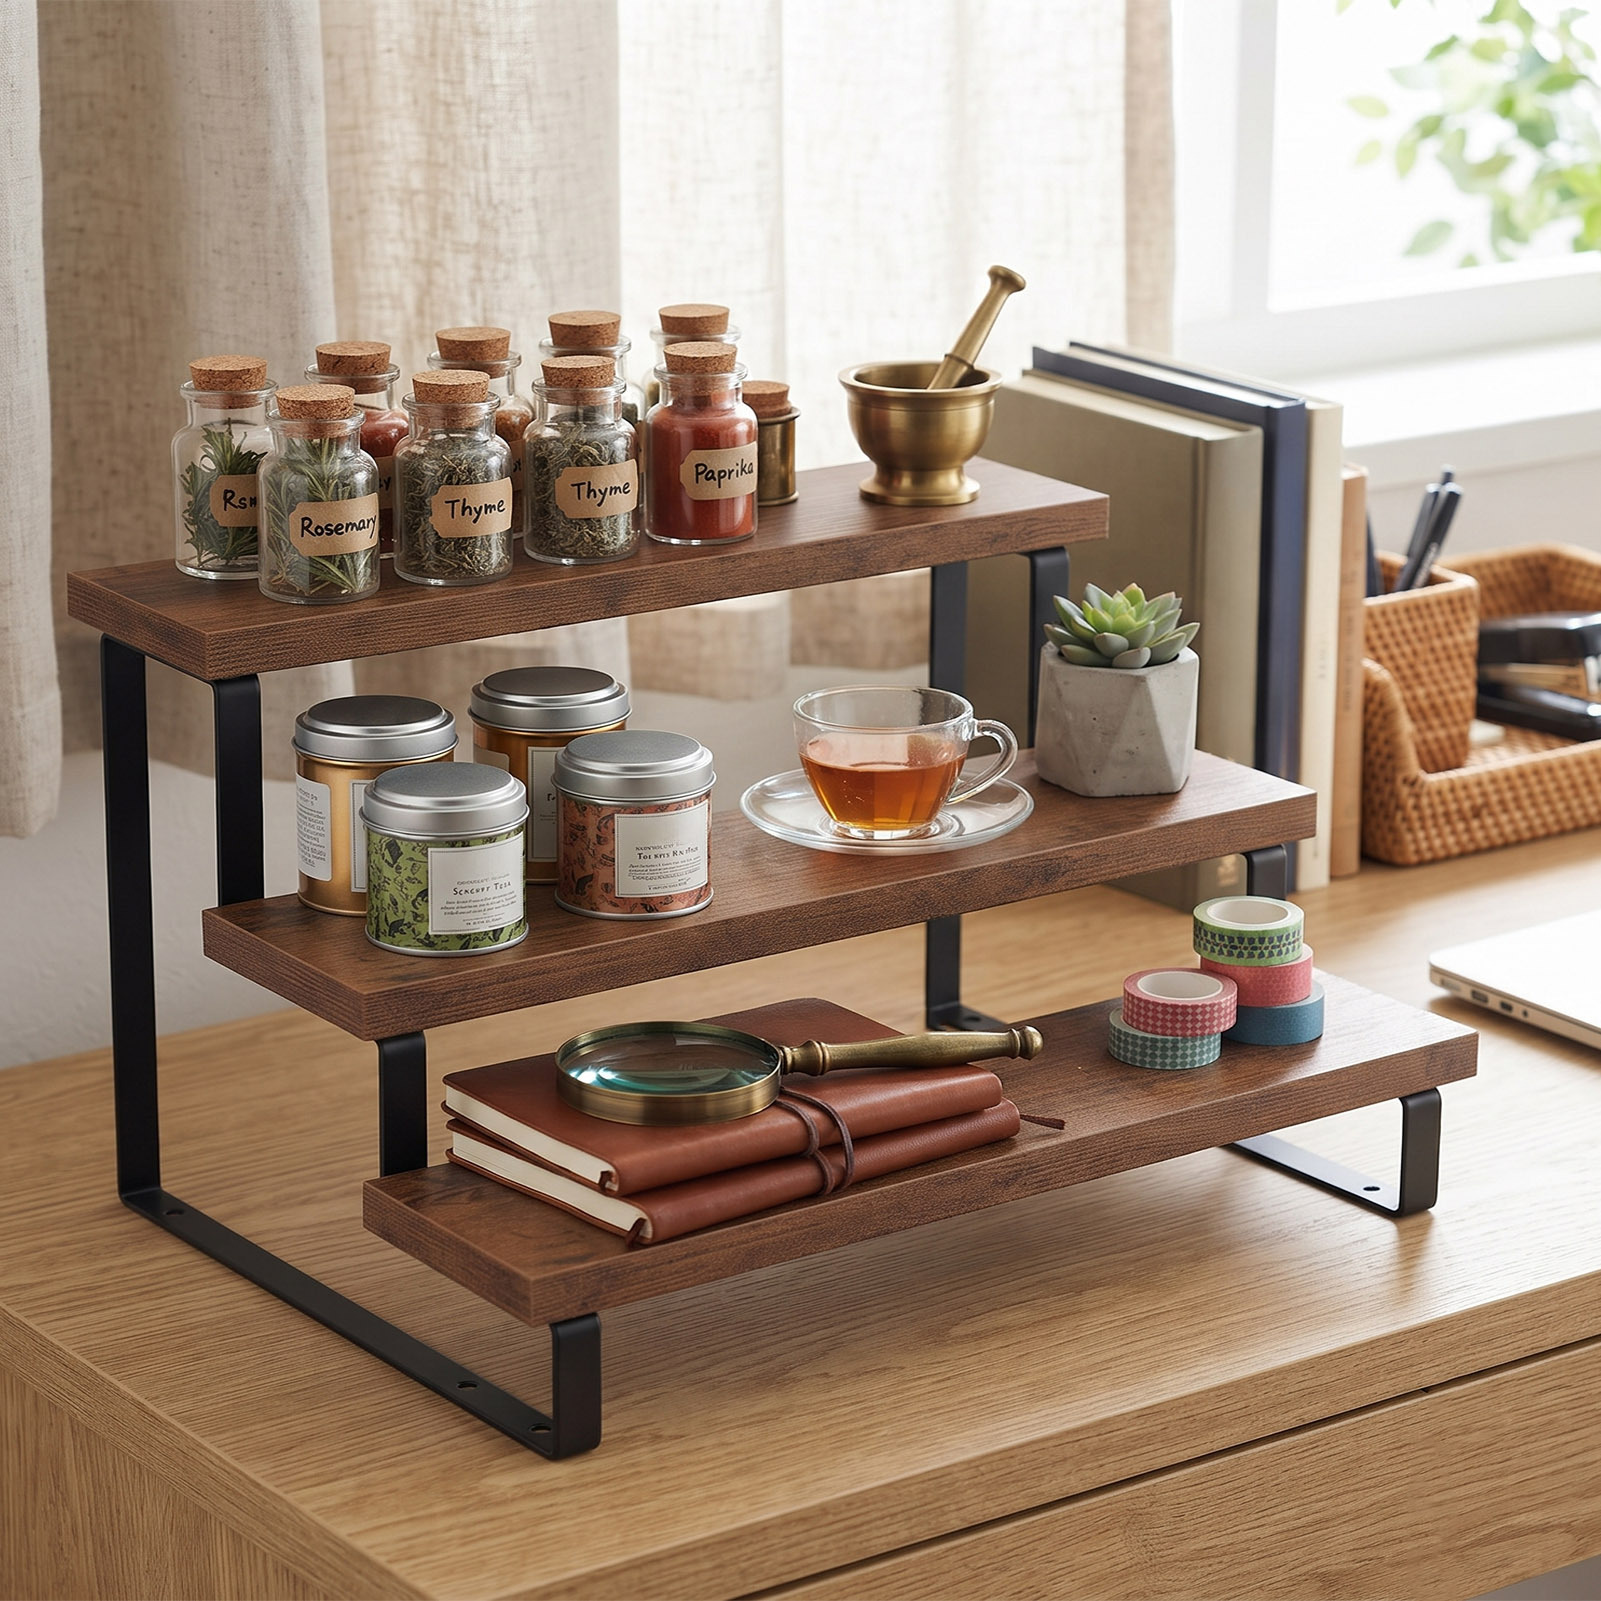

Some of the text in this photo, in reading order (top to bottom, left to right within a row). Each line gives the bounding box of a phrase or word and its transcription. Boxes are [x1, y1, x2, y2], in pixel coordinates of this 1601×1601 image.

[694, 458, 755, 489] Paprika
[570, 480, 632, 508] Thyme
[444, 498, 506, 525] Thyme
[300, 515, 377, 539] Rosemary
